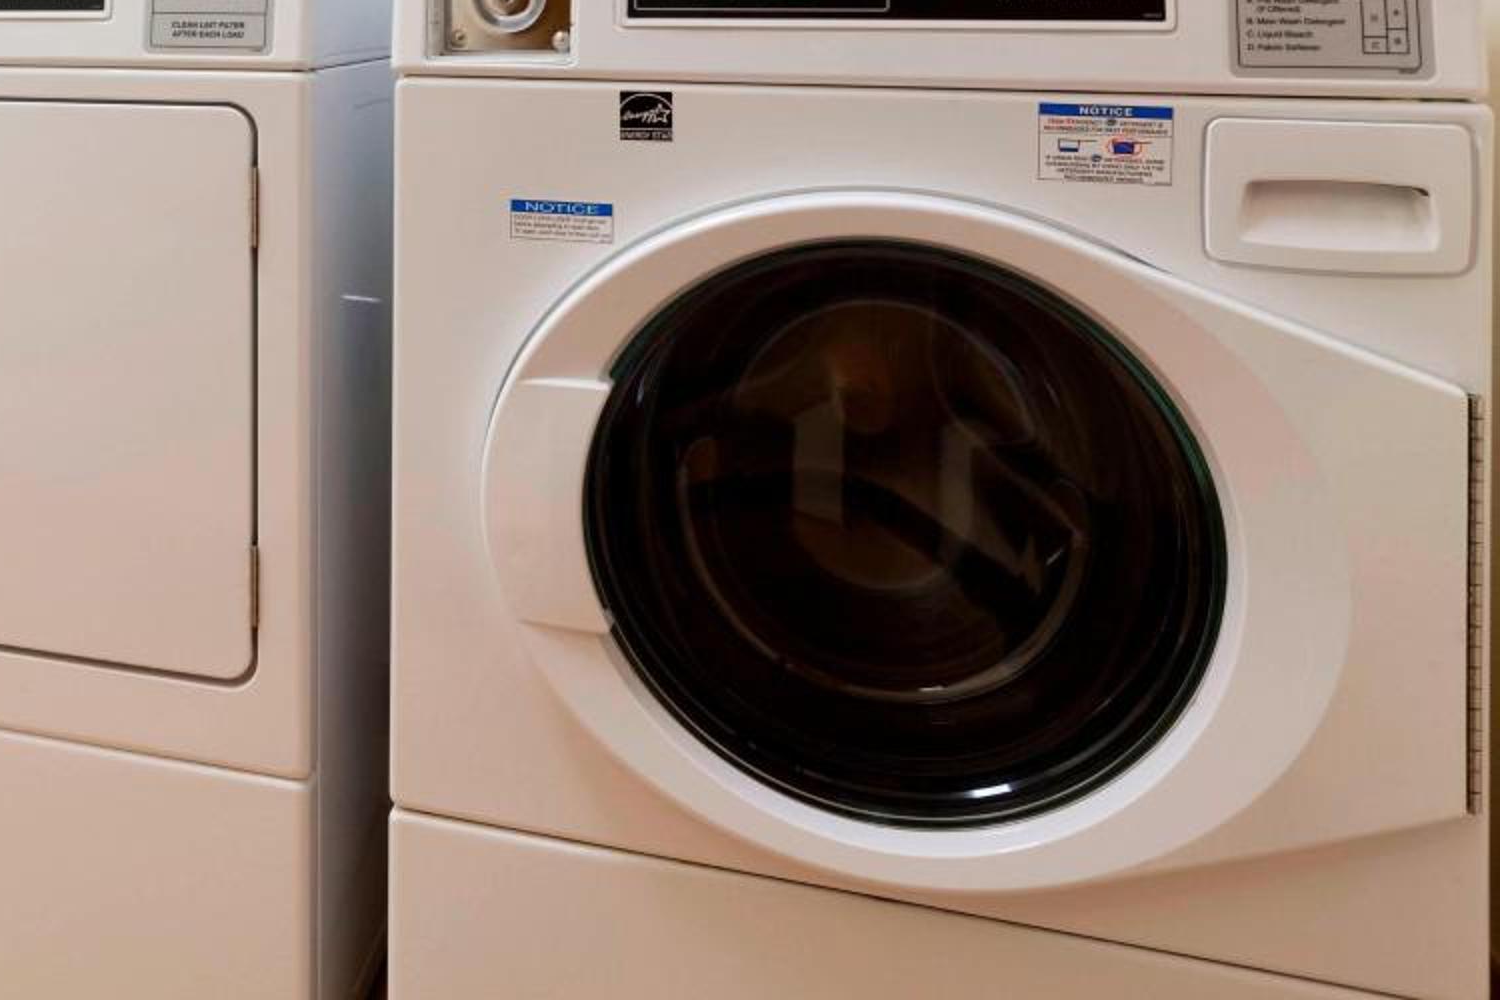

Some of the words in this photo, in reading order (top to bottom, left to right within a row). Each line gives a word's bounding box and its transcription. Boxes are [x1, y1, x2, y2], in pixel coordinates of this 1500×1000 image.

[172, 30, 197, 38] AFTER
[199, 30, 220, 39] EACH
[222, 31, 244, 39] LOAD
[1079, 106, 1133, 117] NOTICE
[524, 201, 597, 214] NOTICE
